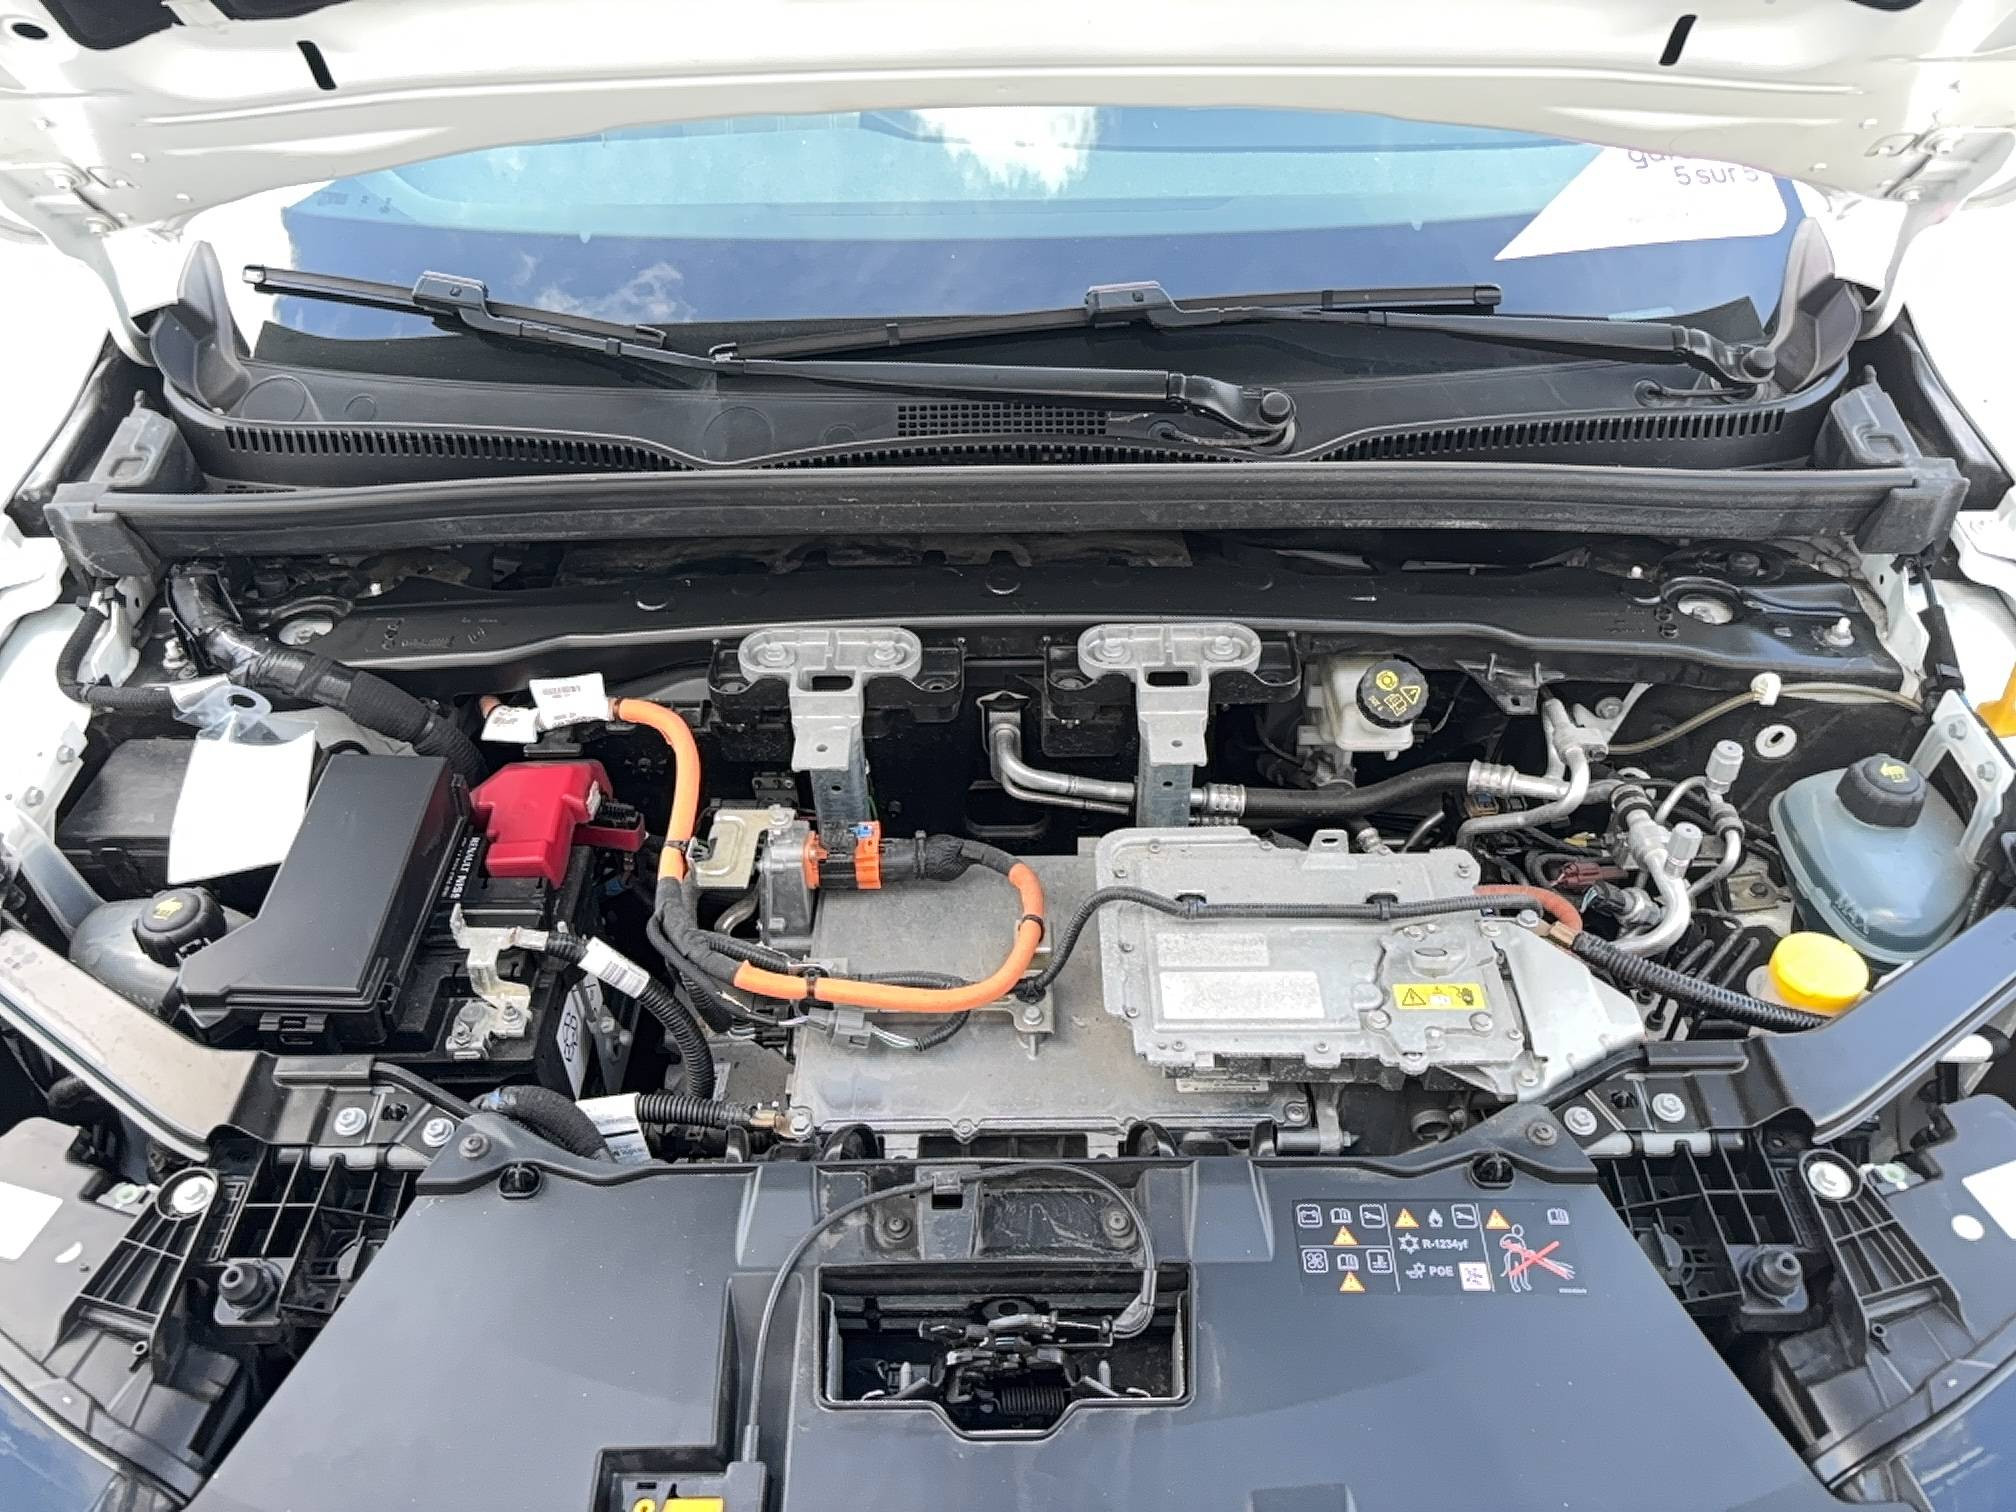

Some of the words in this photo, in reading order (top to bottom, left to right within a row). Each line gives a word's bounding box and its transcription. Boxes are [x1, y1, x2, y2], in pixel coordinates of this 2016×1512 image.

[1673, 165, 1692, 186] 5
[1695, 168, 1735, 184] sur
[460, 836, 481, 873] RENAULT
[1421, 1238, 1469, 1251] R-1234yf
[1429, 1265, 1455, 1277] POE
